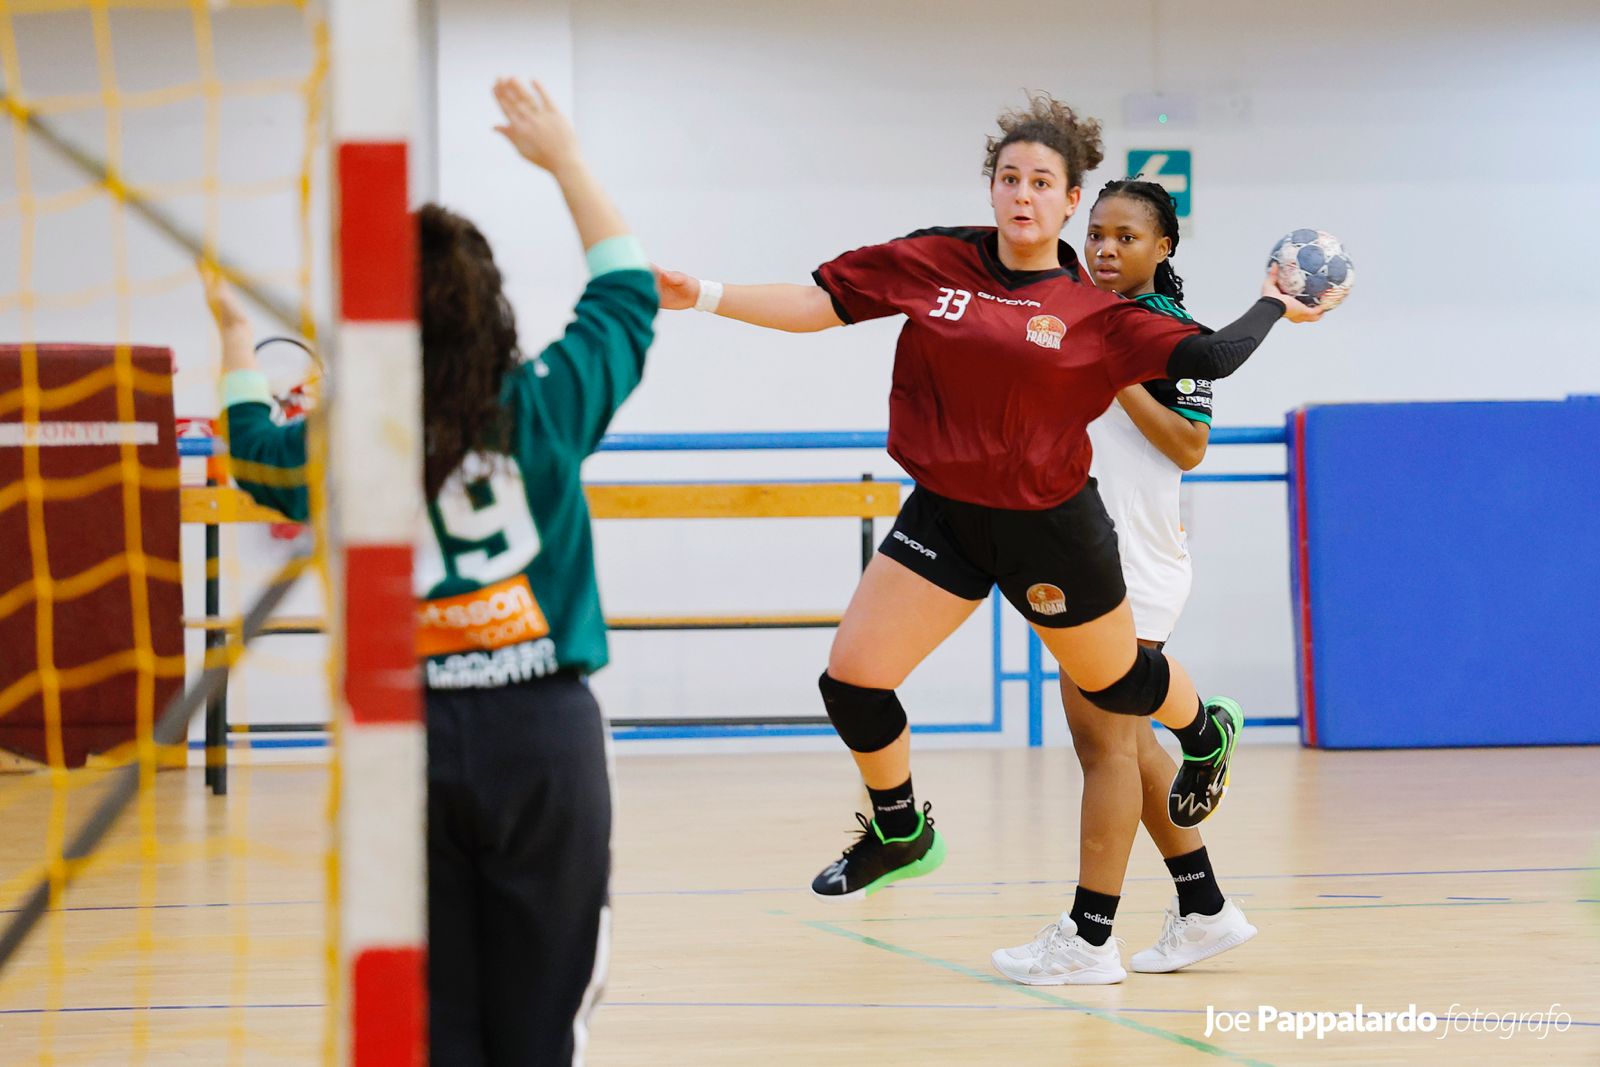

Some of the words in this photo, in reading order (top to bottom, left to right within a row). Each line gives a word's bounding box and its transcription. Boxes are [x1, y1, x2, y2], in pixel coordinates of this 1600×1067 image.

[928, 286, 972, 321] 33
[977, 291, 1042, 308] GIVOVA
[893, 530, 937, 560] GIVOVA
